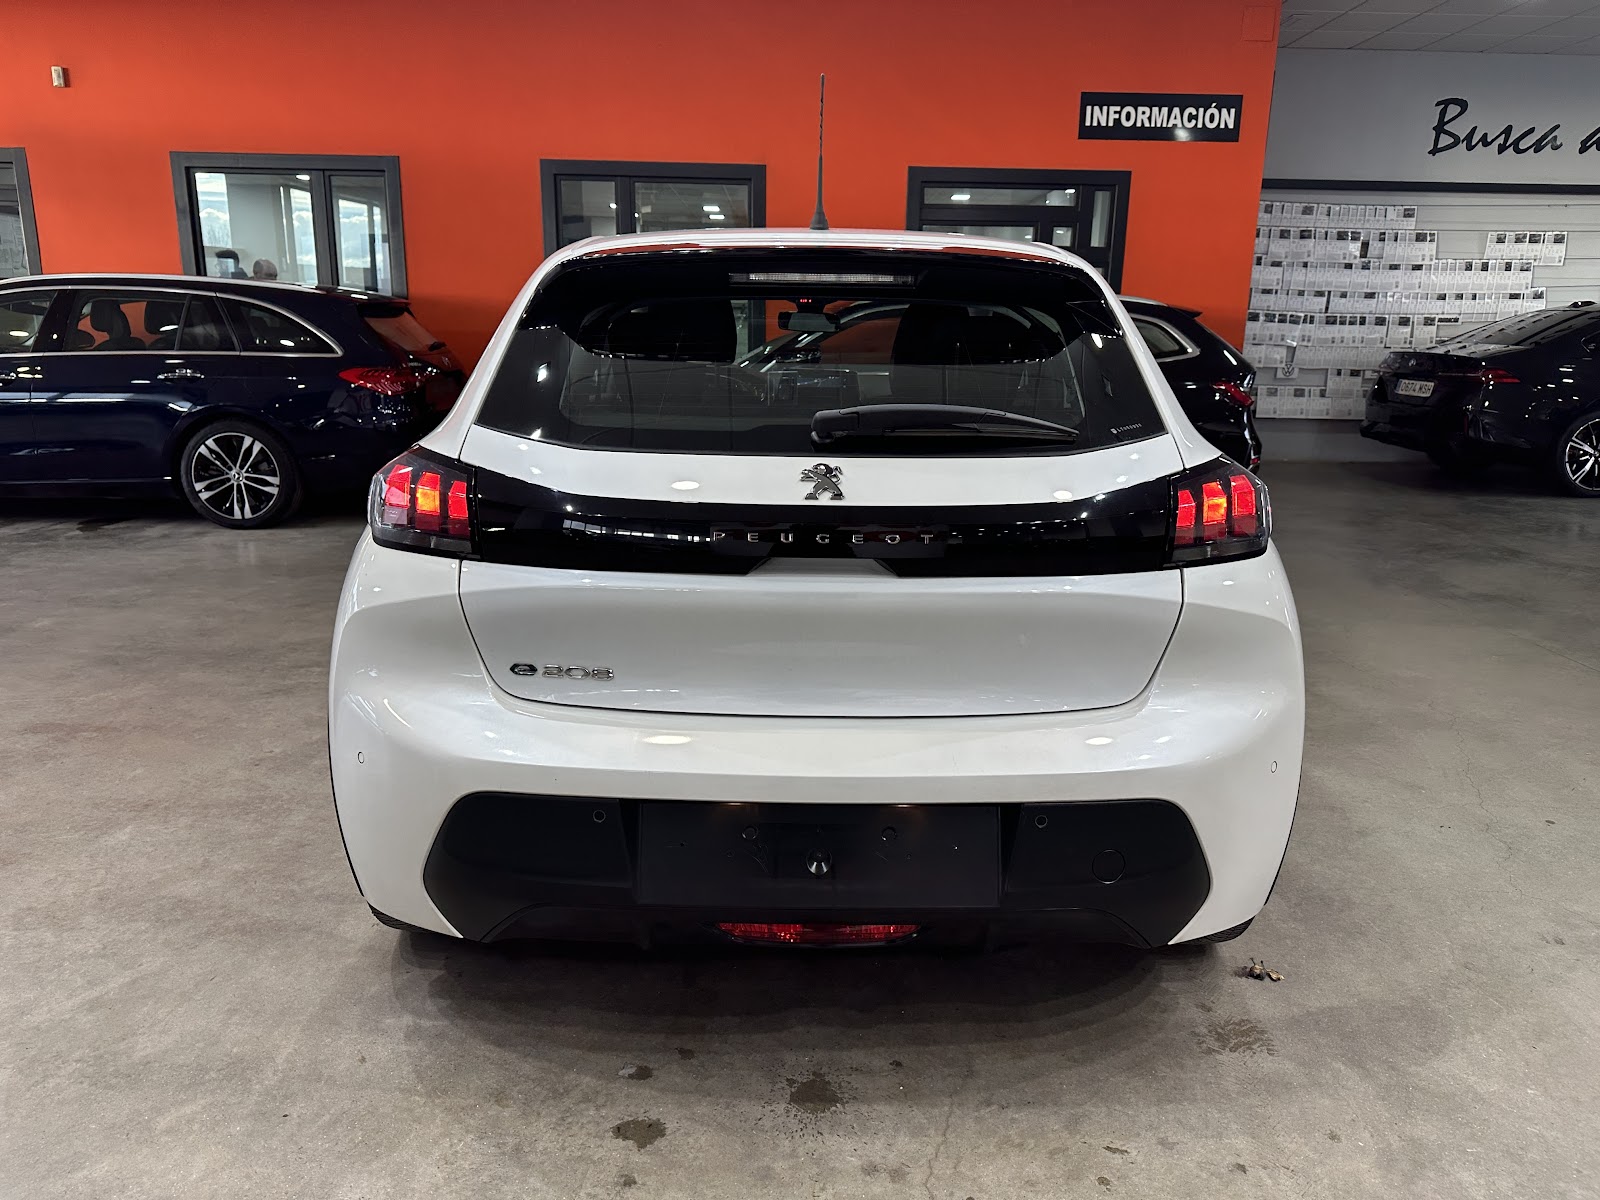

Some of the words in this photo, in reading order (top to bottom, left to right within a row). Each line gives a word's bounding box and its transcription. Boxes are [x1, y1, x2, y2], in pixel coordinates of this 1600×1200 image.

[1085, 103, 1236, 129] INFORMACIÓN
[1428, 97, 1563, 156] Busca
[713, 531, 934, 544] PEUGEOT
